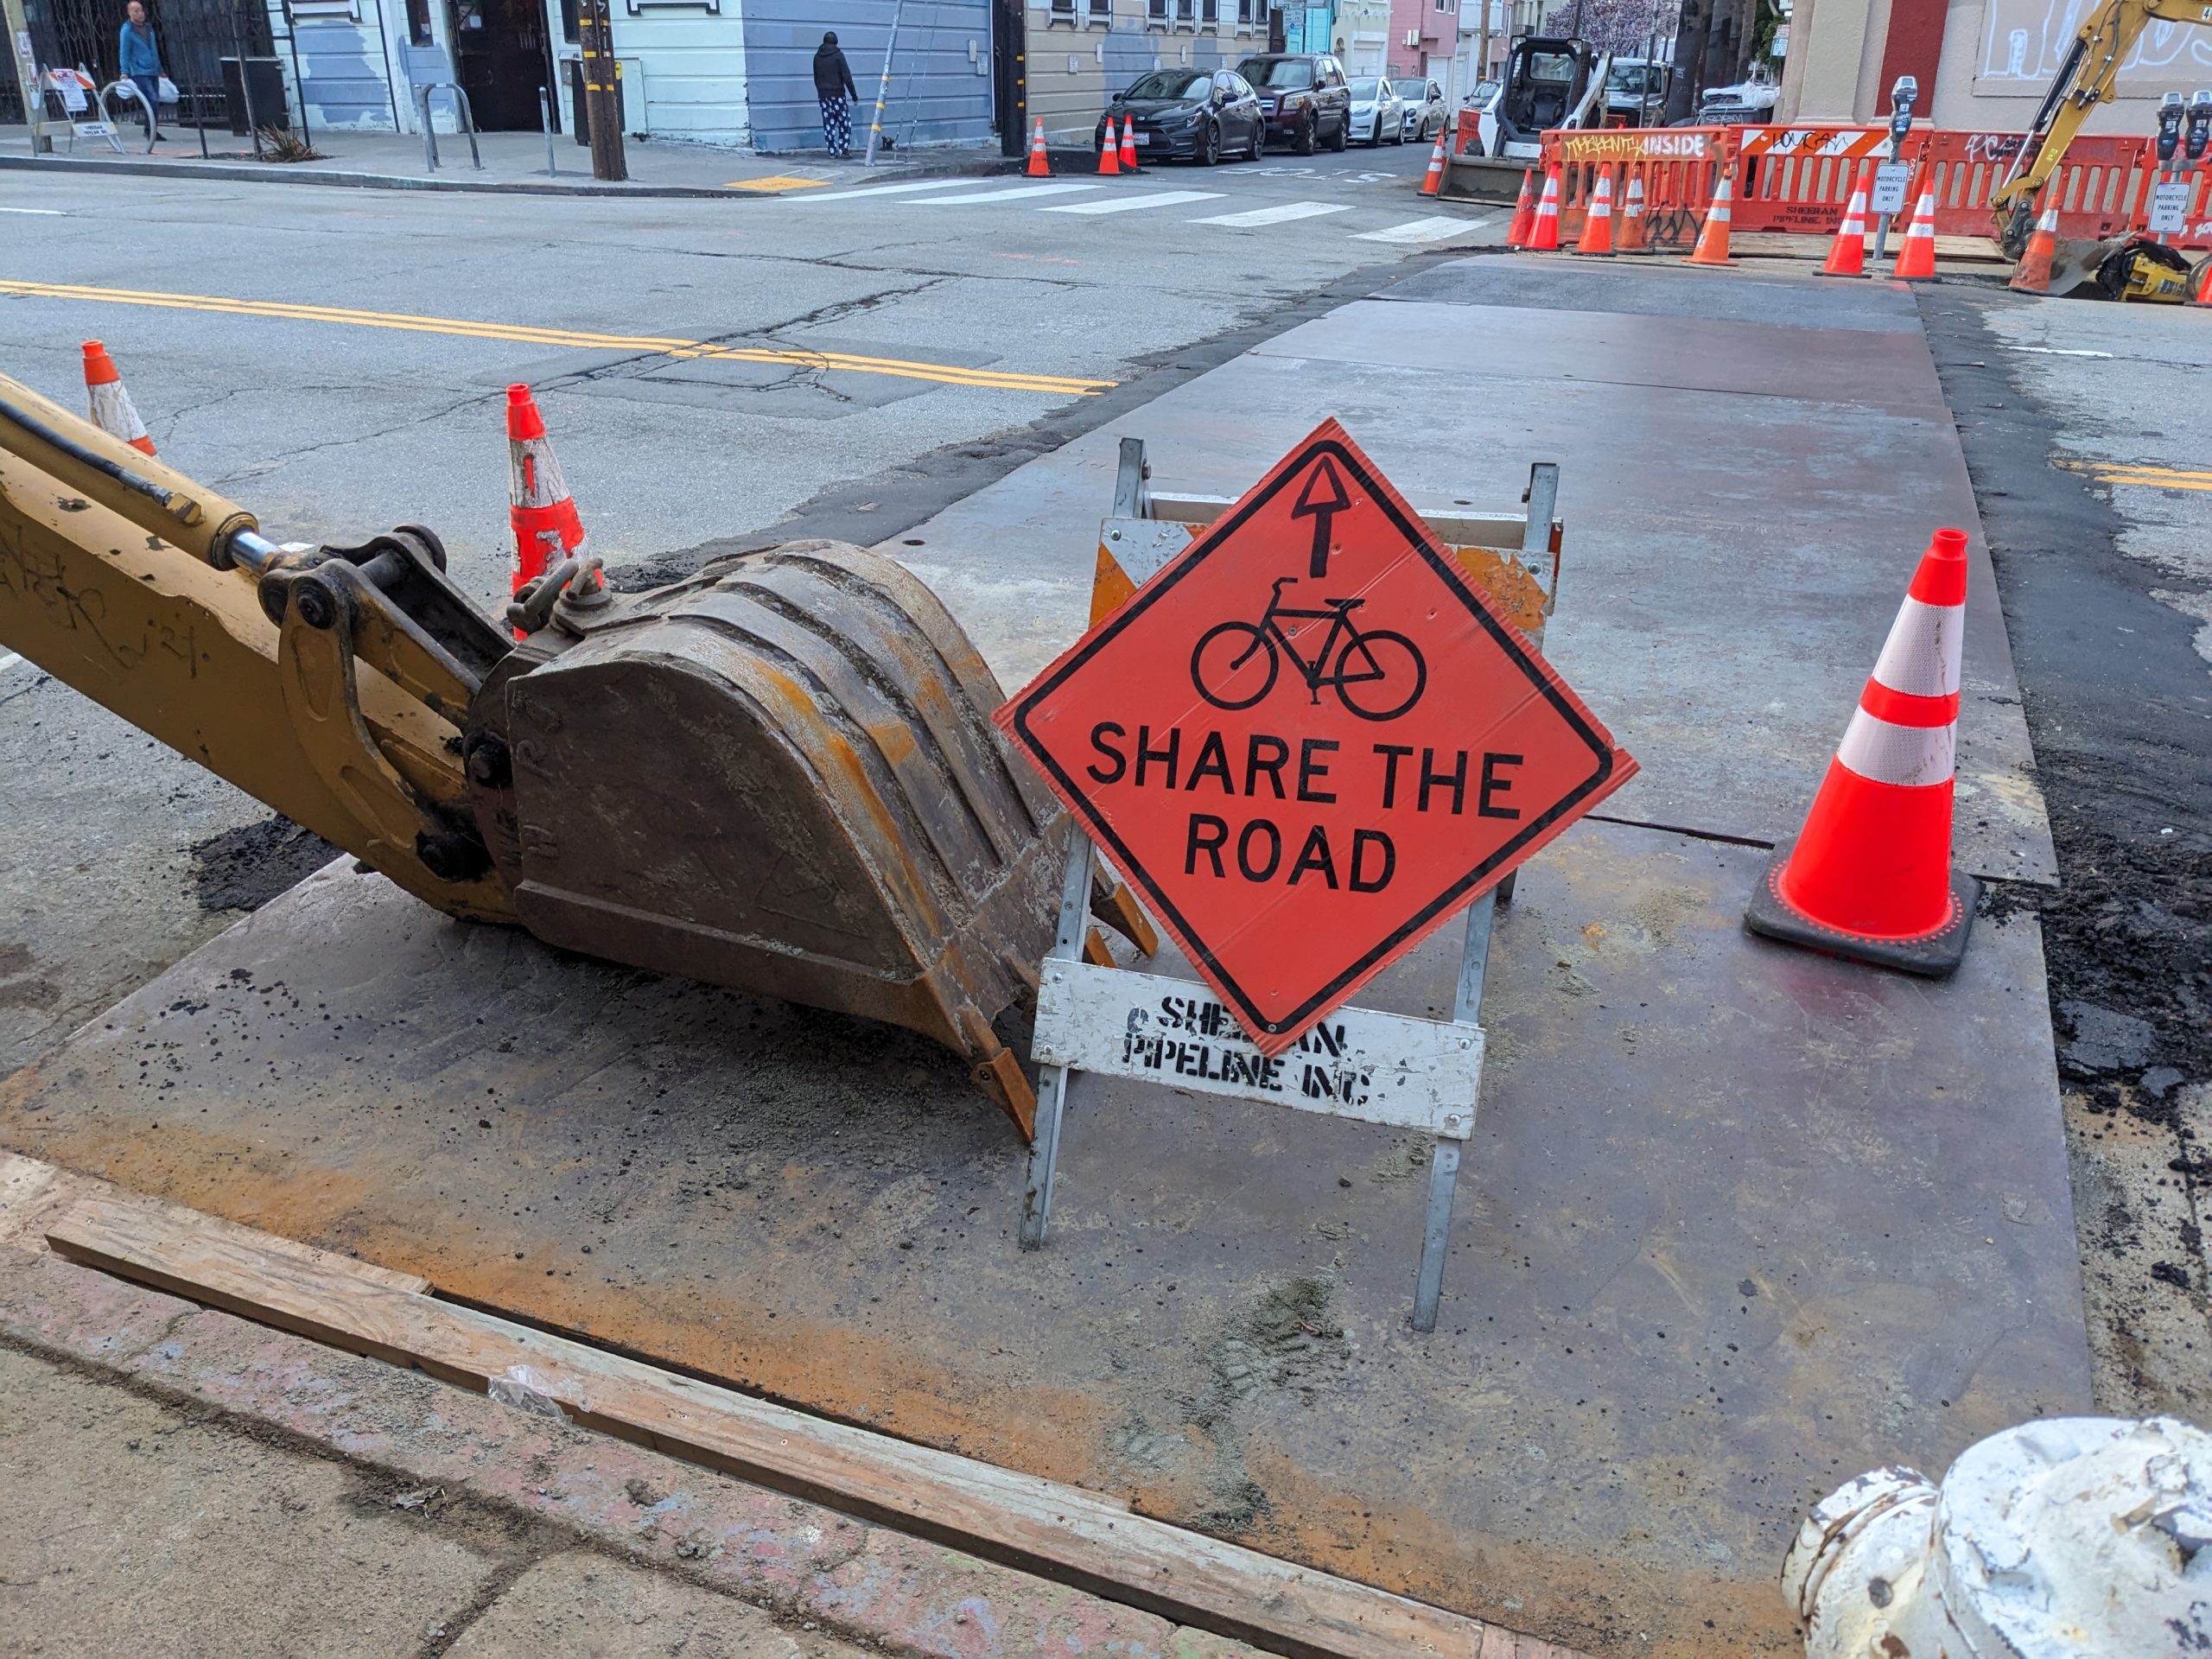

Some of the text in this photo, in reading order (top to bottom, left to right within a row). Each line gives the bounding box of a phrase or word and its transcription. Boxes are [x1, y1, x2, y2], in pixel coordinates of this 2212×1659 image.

[1086, 721, 1524, 819] SHARE THE
[1185, 813, 1396, 893] ROAD
[1122, 1033, 1370, 1106] PIPELINE INC
